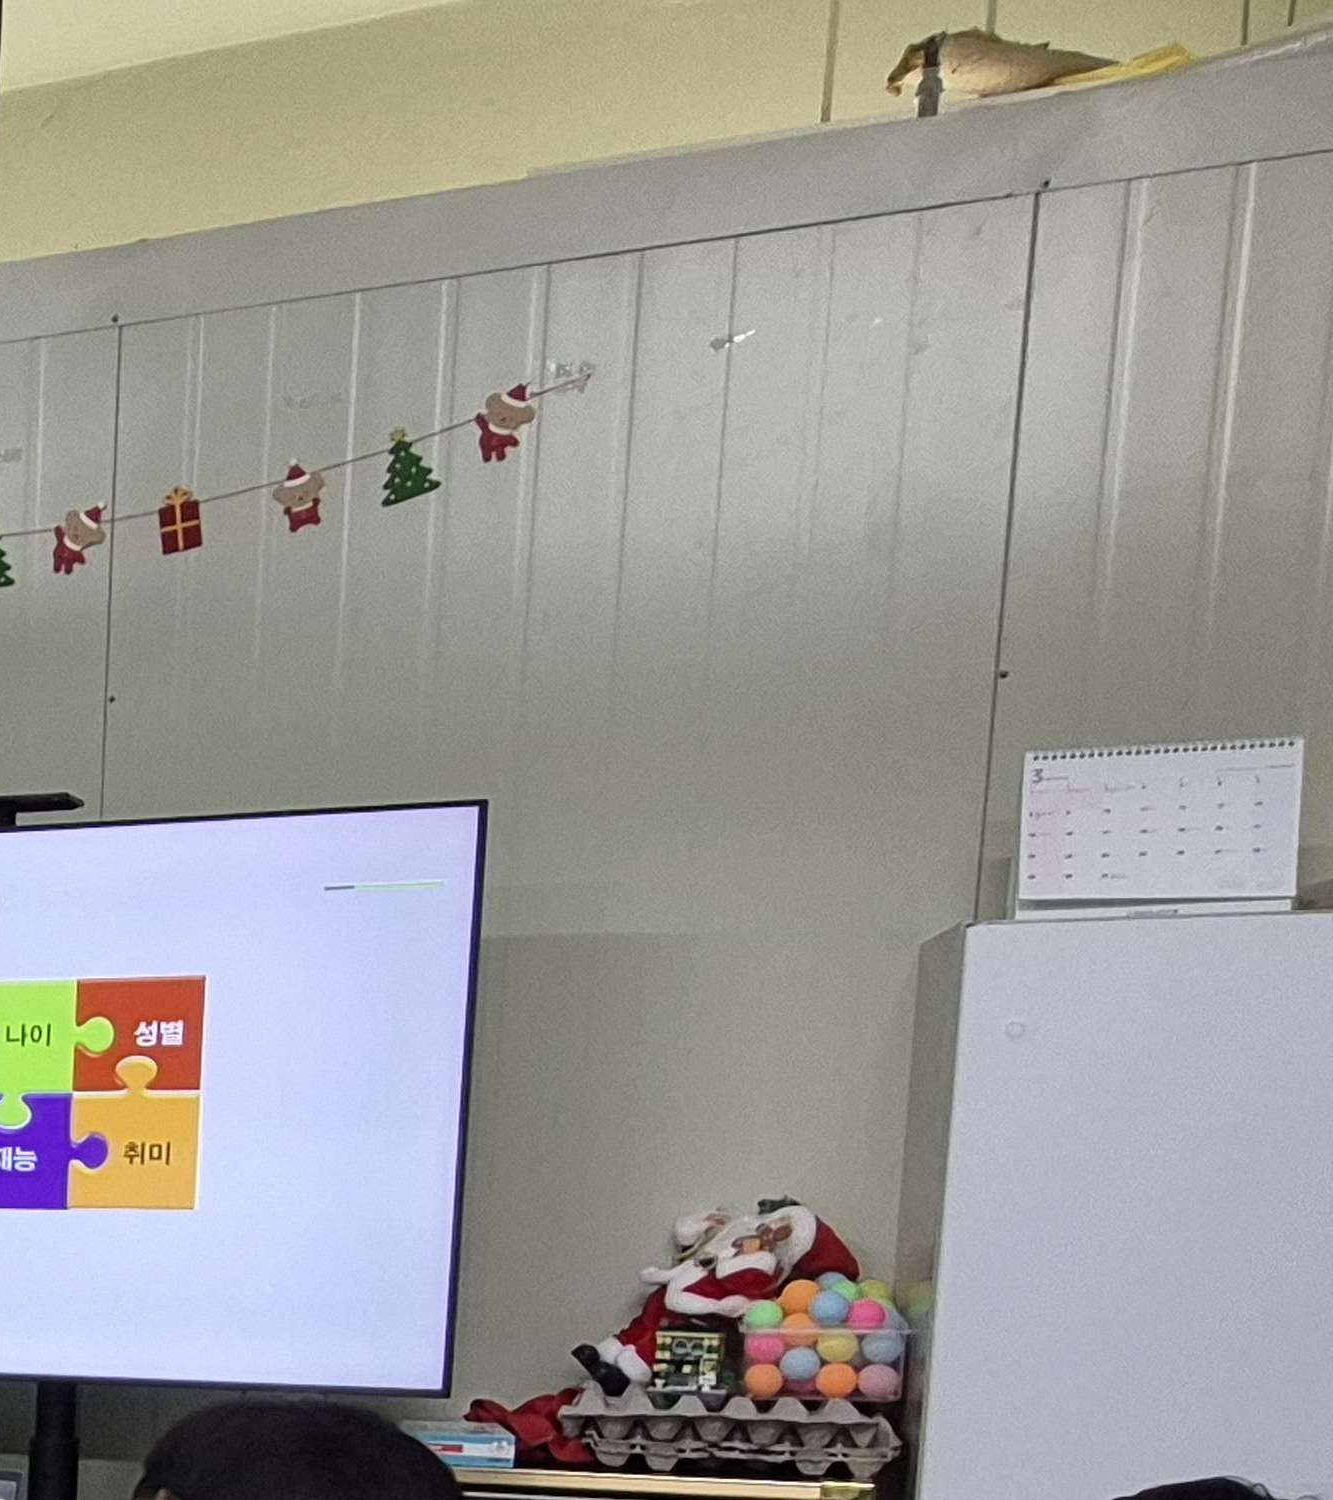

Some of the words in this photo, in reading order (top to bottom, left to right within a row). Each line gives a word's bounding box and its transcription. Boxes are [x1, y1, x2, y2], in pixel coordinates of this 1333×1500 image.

[5, 1023, 52, 1048] 나이
[133, 1019, 185, 1048] 성별
[122, 1141, 172, 1166] 취미
